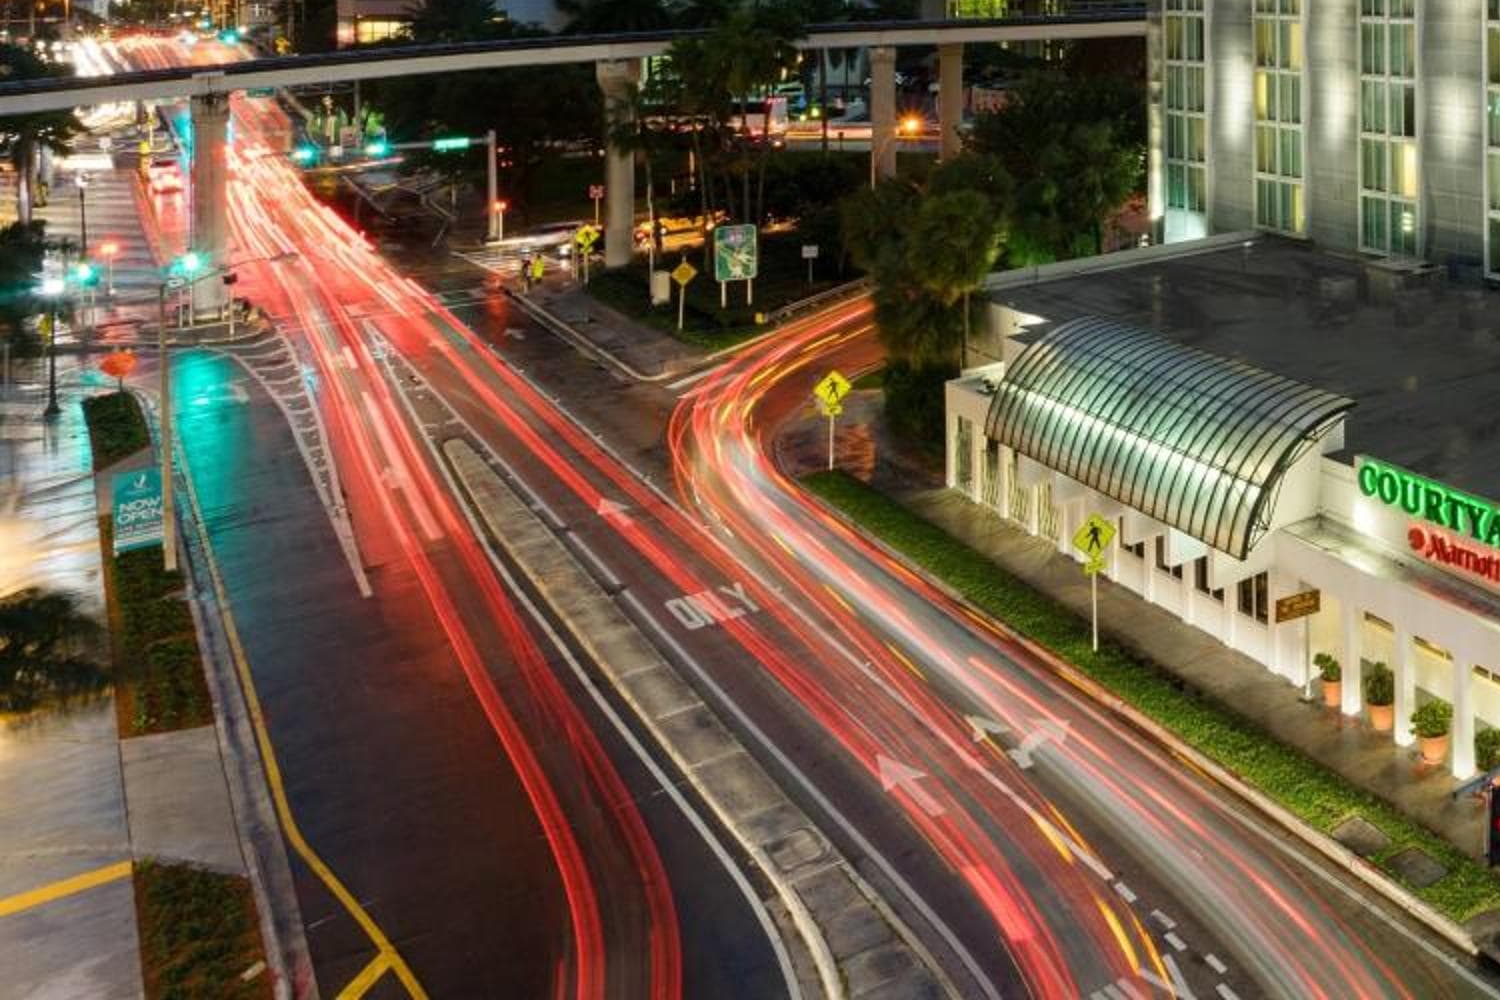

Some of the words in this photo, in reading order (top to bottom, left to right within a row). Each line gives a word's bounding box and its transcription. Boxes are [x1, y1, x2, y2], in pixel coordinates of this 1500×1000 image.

[119, 496, 161, 514] NOW
[117, 508, 164, 525] OPEN
[664, 582, 760, 630] ONLY
